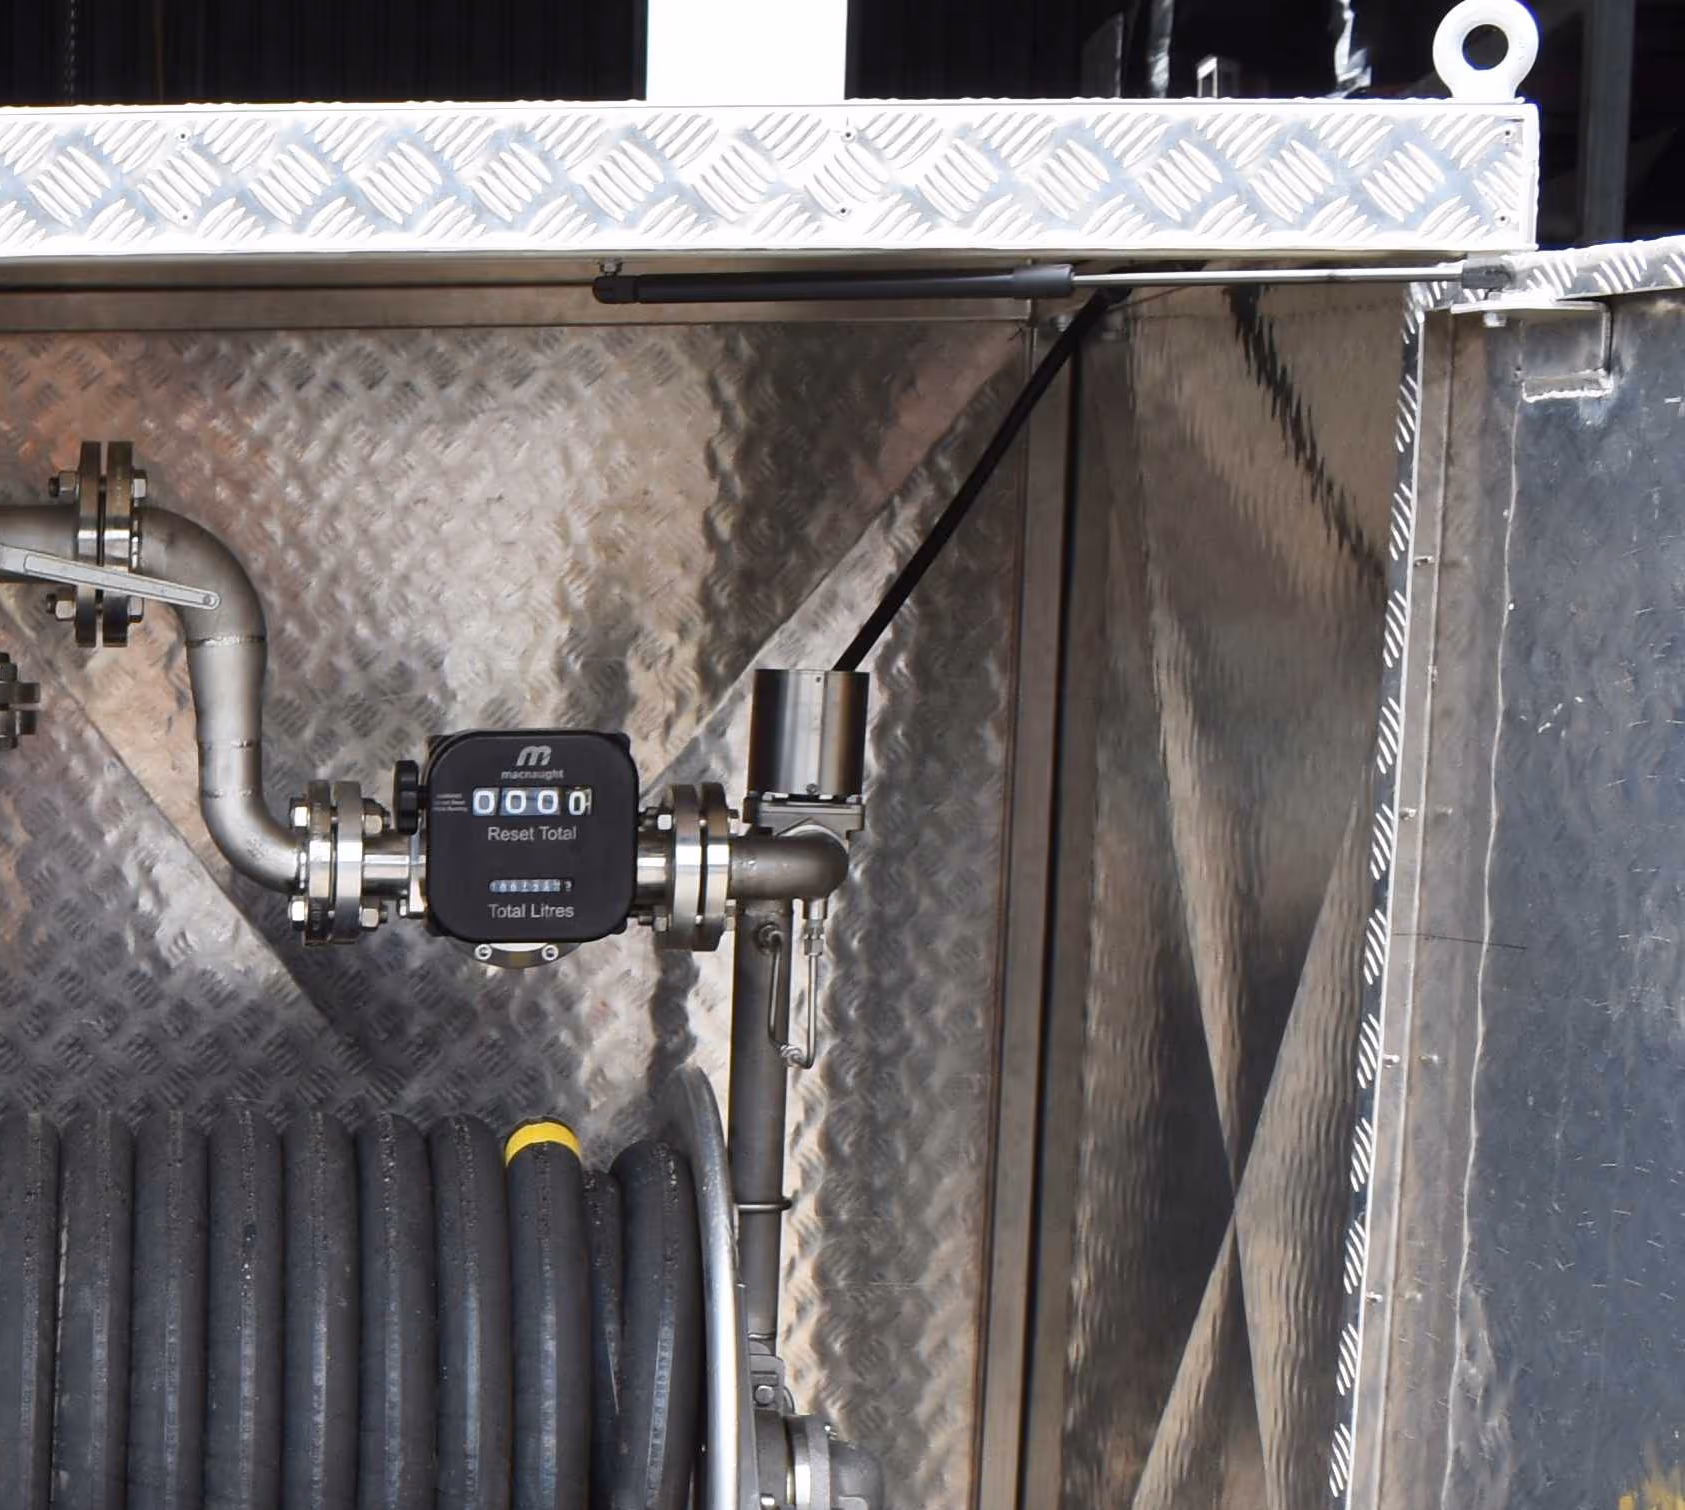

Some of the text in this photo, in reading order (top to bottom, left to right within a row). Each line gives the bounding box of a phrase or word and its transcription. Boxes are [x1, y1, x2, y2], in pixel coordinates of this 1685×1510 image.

[501, 770, 565, 781] macnaught
[487, 825, 578, 842] Reset Total
[488, 903, 575, 918] Total Litres
